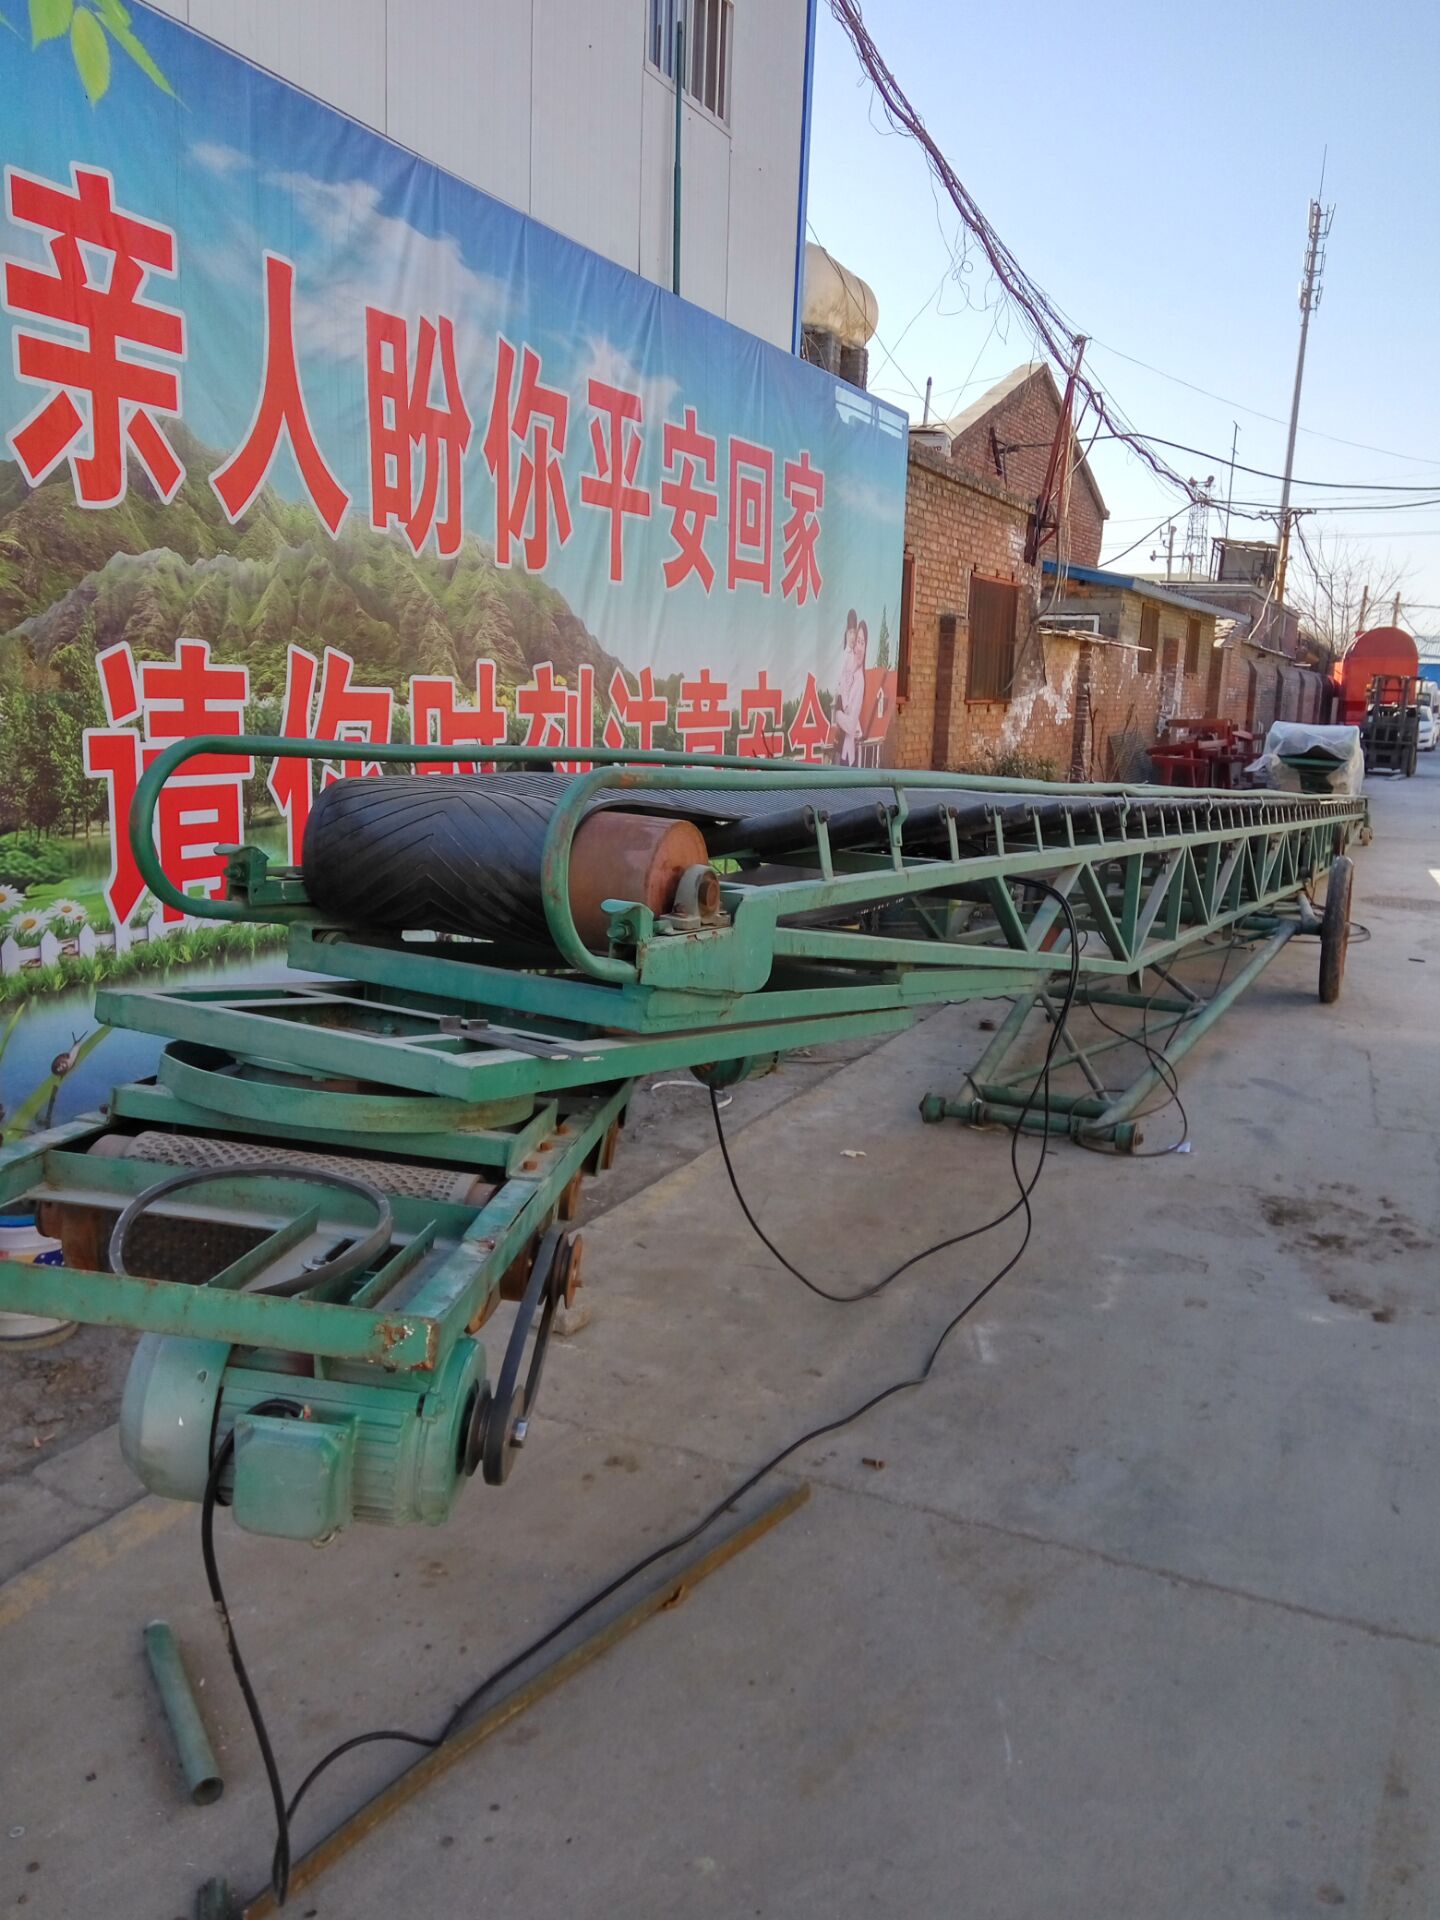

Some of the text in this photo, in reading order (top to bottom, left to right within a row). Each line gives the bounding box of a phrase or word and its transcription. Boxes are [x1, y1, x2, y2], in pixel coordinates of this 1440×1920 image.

[3, 161, 826, 605] 亲人盼你平安回家
